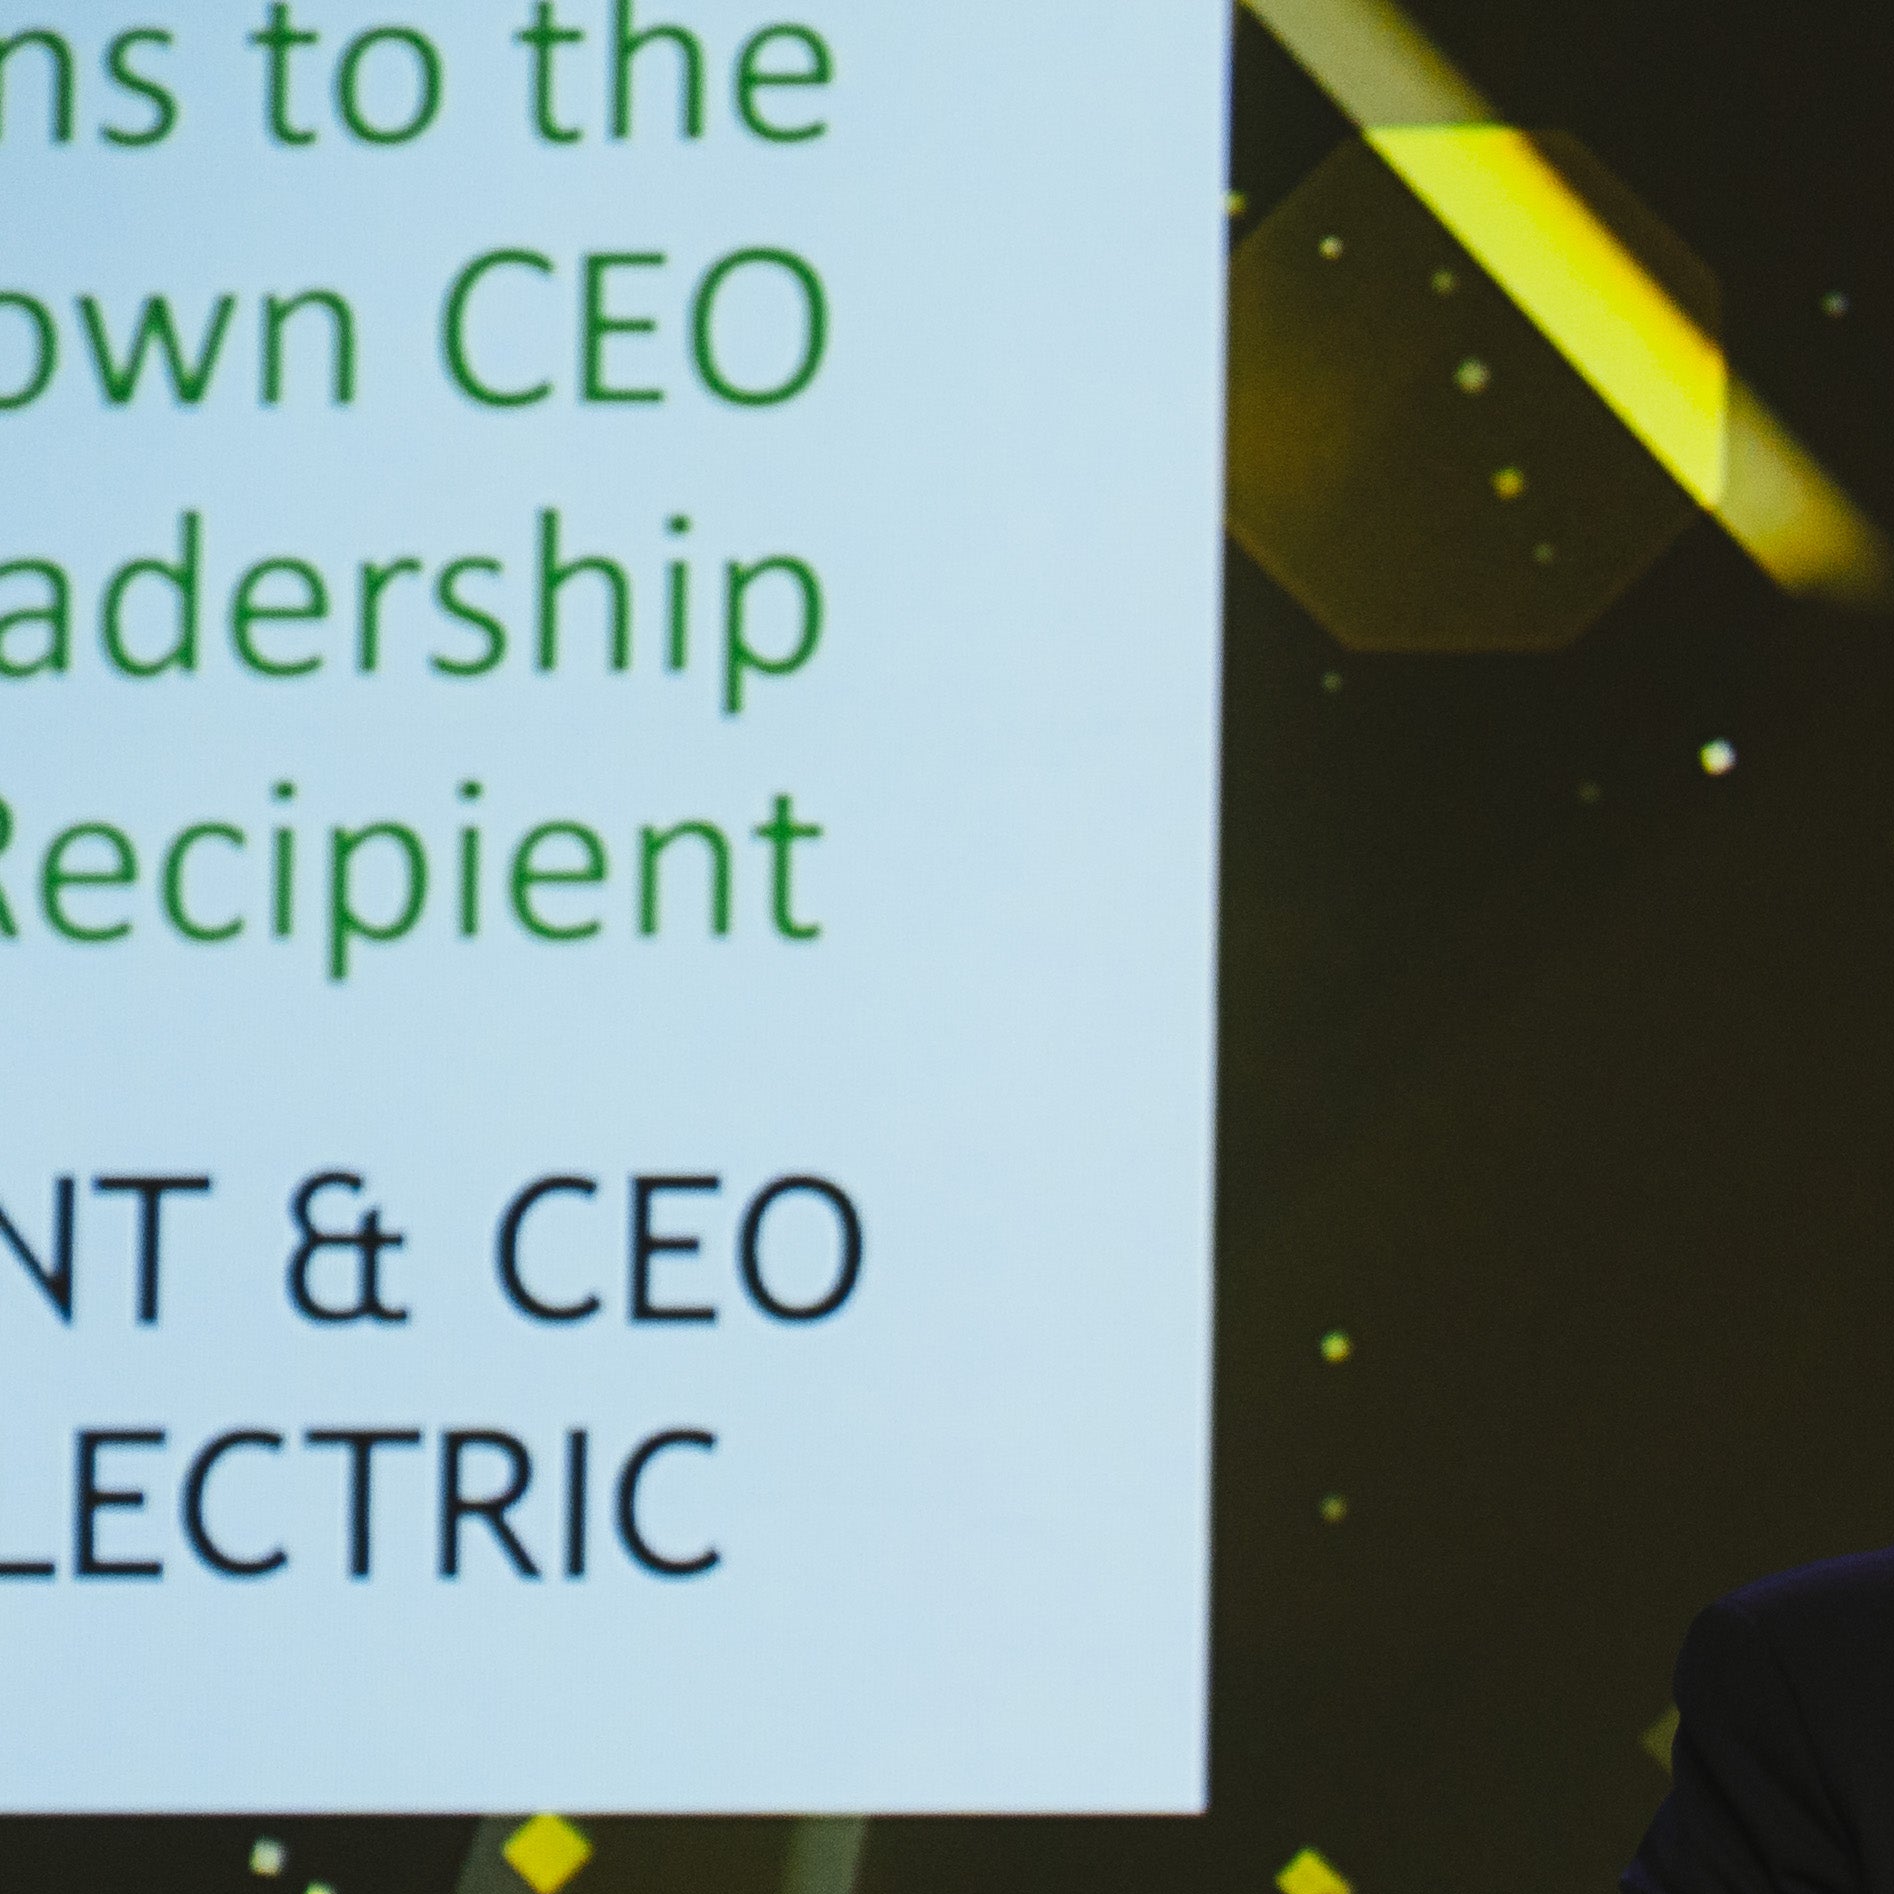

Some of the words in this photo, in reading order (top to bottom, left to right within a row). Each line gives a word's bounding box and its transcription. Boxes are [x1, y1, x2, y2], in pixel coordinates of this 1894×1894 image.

[244, 0, 446, 151] to
[510, 0, 834, 149] the
[437, 246, 830, 411] CEO
[0, 507, 826, 719] adership
[0, 779, 823, 983] ecipient
[283, 1168, 413, 1330] &
[493, 1173, 867, 1330] CEO
[0, 1425, 723, 1585] ECTRIC
